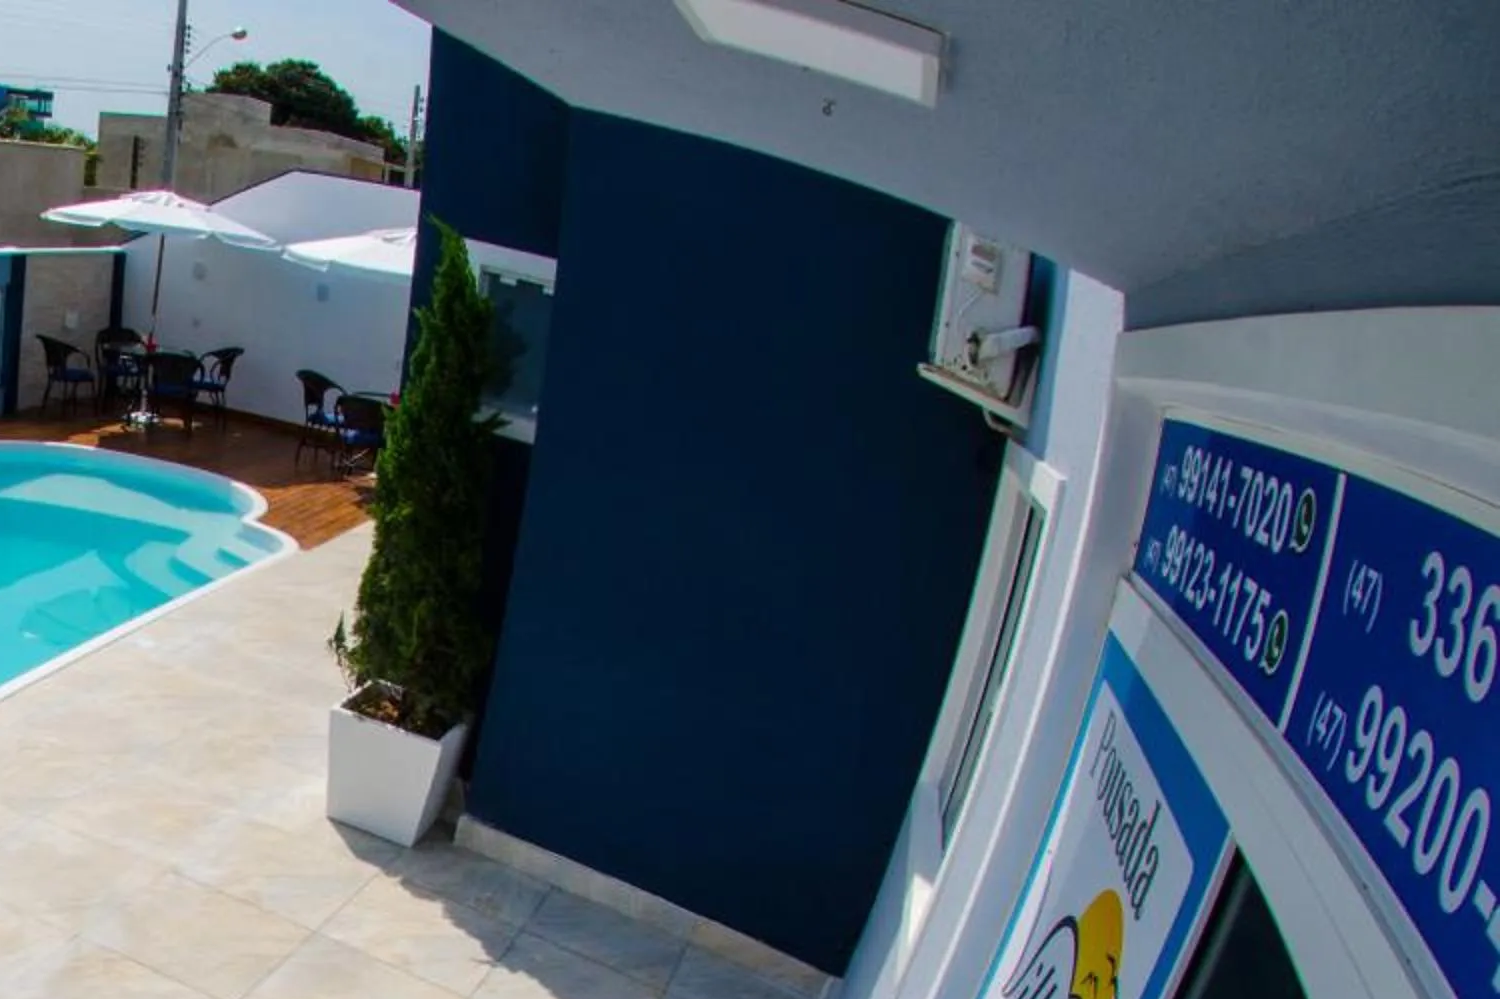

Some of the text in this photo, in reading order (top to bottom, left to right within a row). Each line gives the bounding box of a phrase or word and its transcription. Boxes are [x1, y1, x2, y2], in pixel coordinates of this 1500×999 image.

[1178, 444, 1293, 553] 99141-7020
[1161, 524, 1272, 662] 99123-1175
[1342, 551, 1500, 702] (47) 336
[1090, 710, 1161, 922] Pousada
[1306, 685, 1500, 993] (47) 99200-
